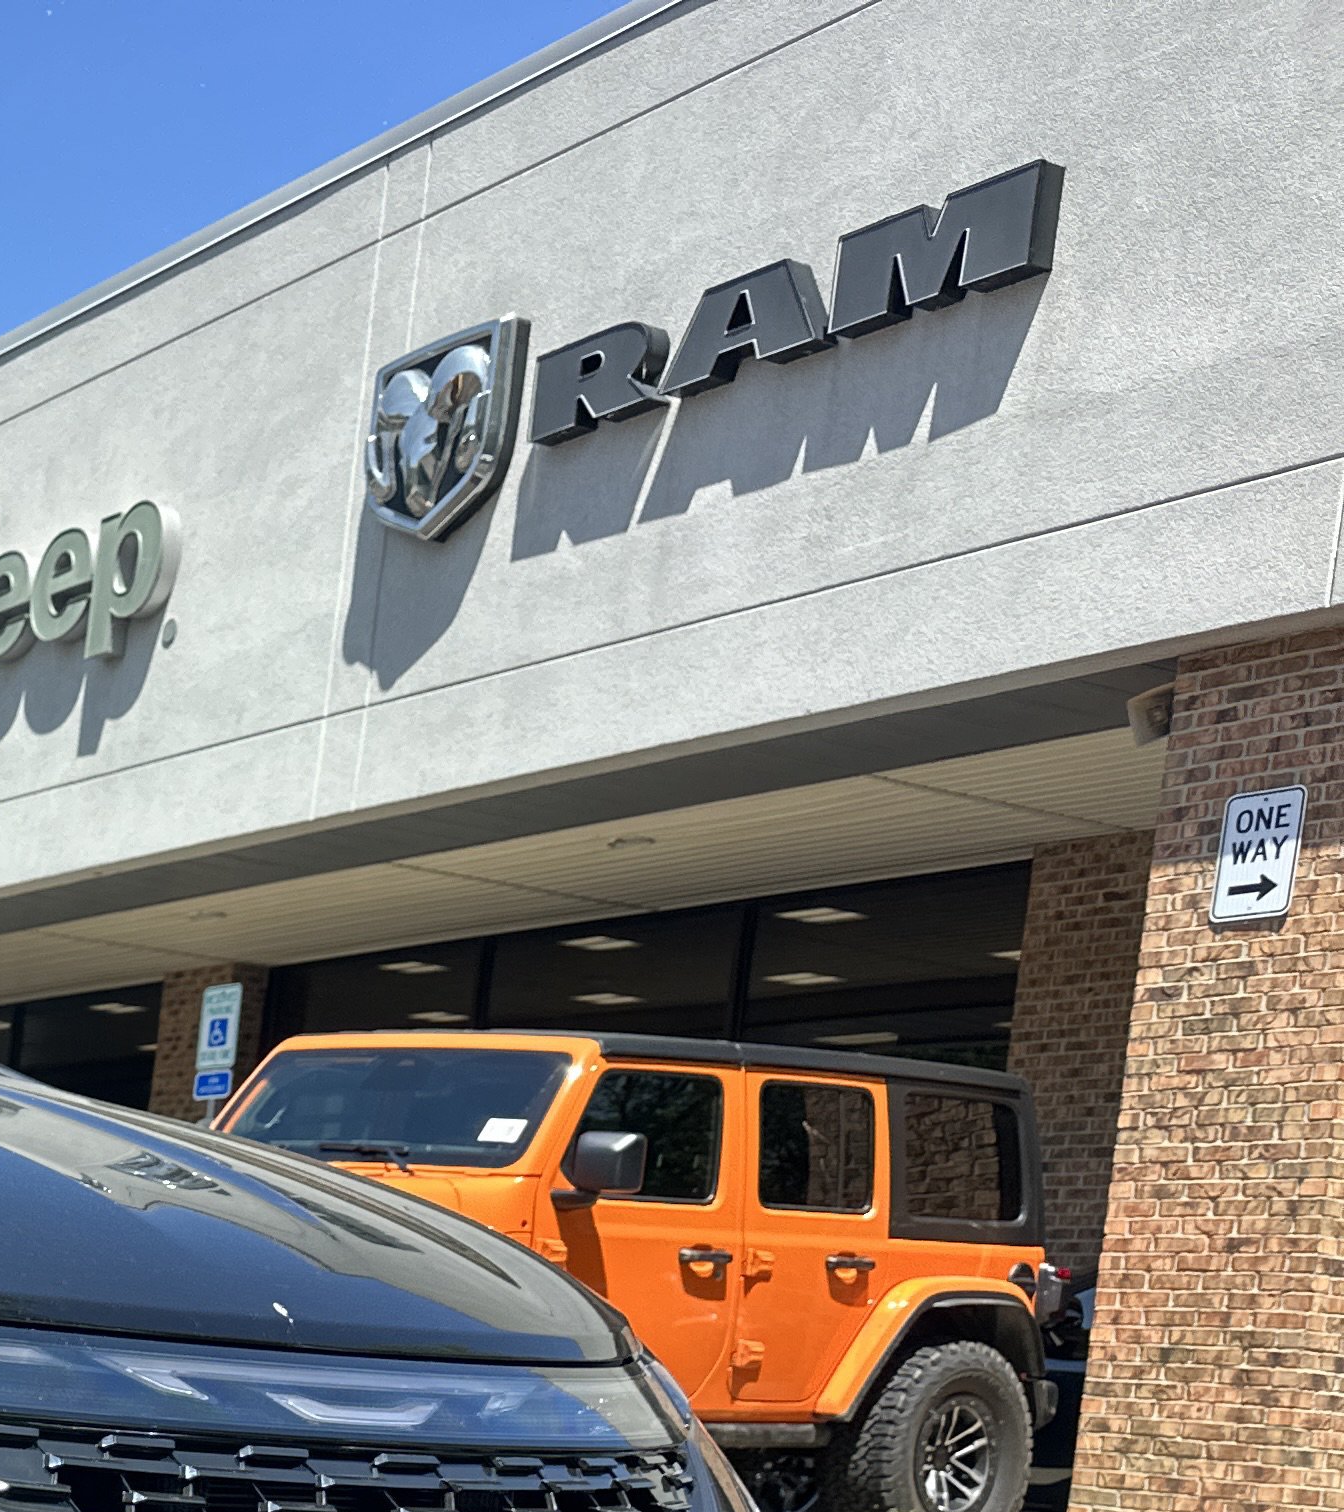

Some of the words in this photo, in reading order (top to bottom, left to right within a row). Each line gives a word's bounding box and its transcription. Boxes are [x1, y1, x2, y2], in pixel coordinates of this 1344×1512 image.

[528, 158, 1065, 446] RAM
[1235, 803, 1292, 834] ONE
[1231, 834, 1289, 866] WAY
